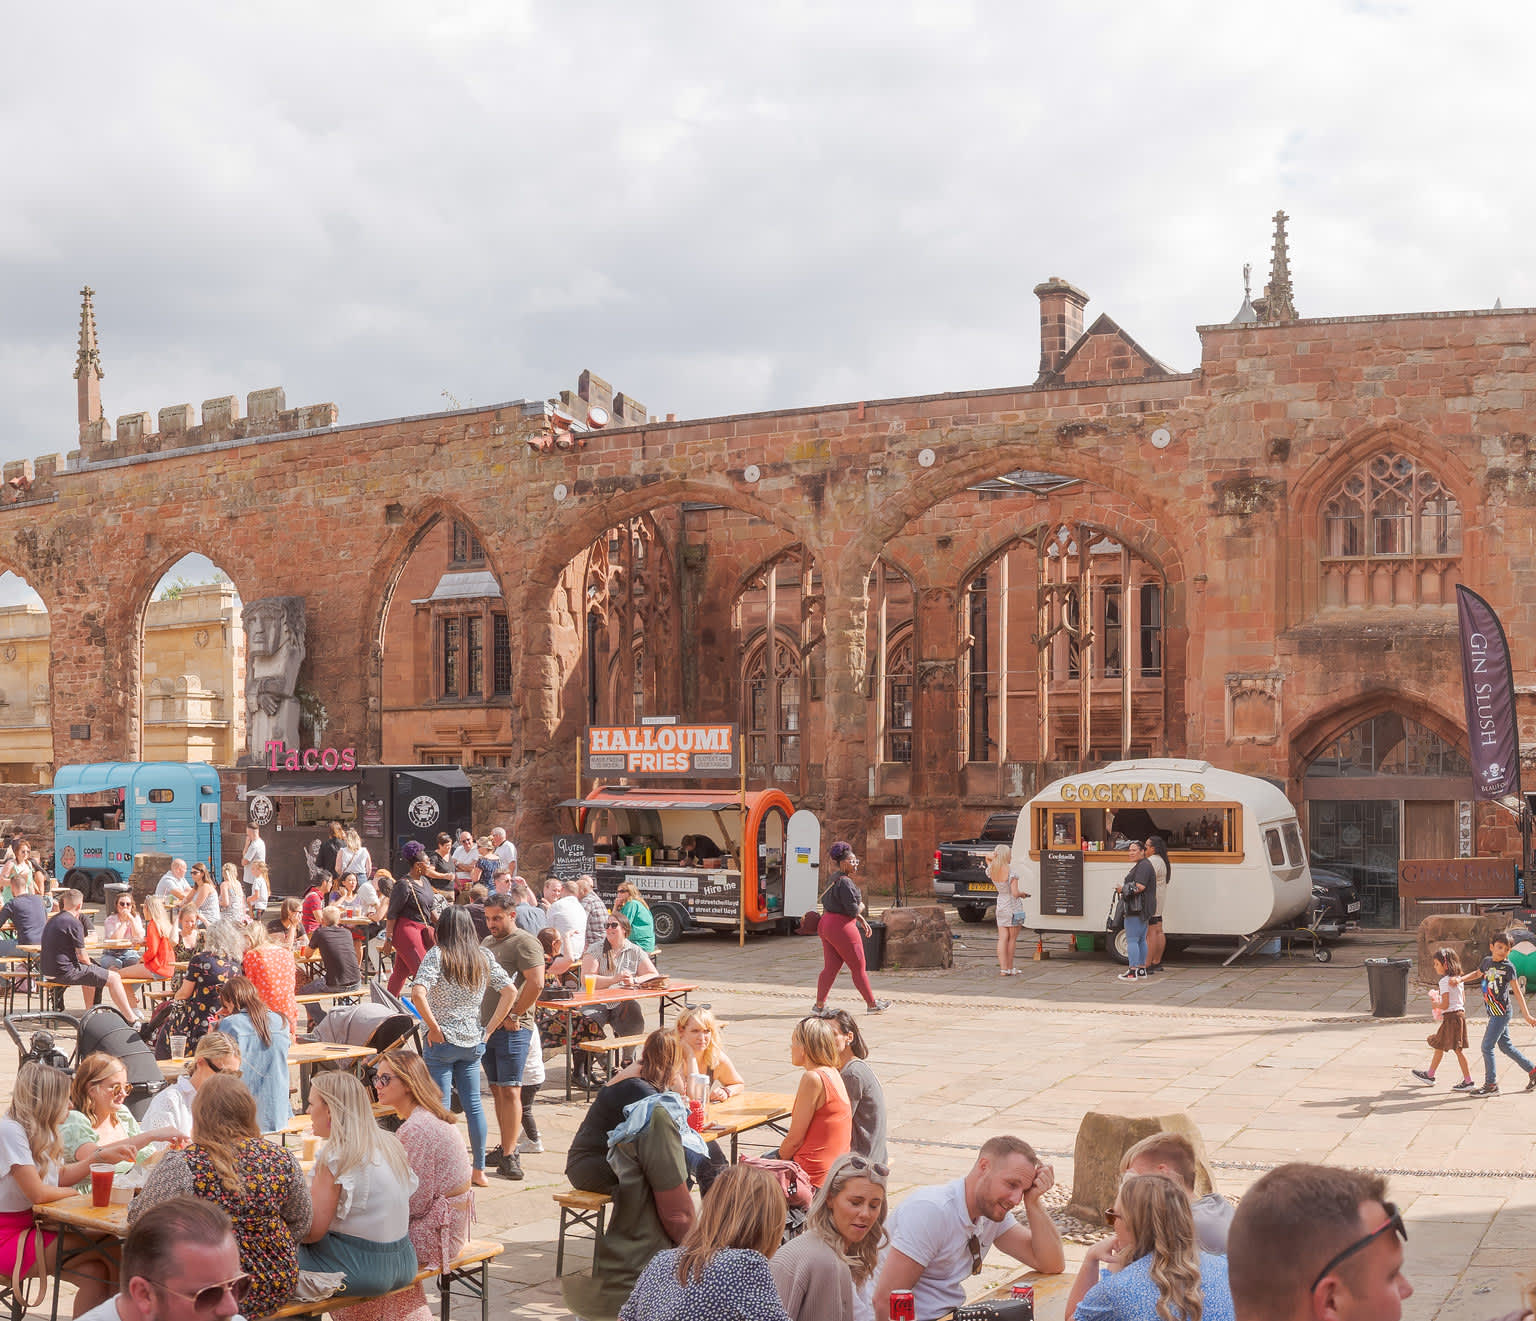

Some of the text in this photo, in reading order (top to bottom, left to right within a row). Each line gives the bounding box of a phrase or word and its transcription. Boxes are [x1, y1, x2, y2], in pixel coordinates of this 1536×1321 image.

[1470, 633, 1496, 745] GIN SLUSH
[591, 728, 730, 751] HALLOUMI
[264, 740, 357, 771] Tacos
[628, 752, 690, 771] FRIES
[1061, 783, 1206, 802] COCKTAILS
[668, 879, 697, 890] CHEF
[704, 881, 737, 896] Hire me
